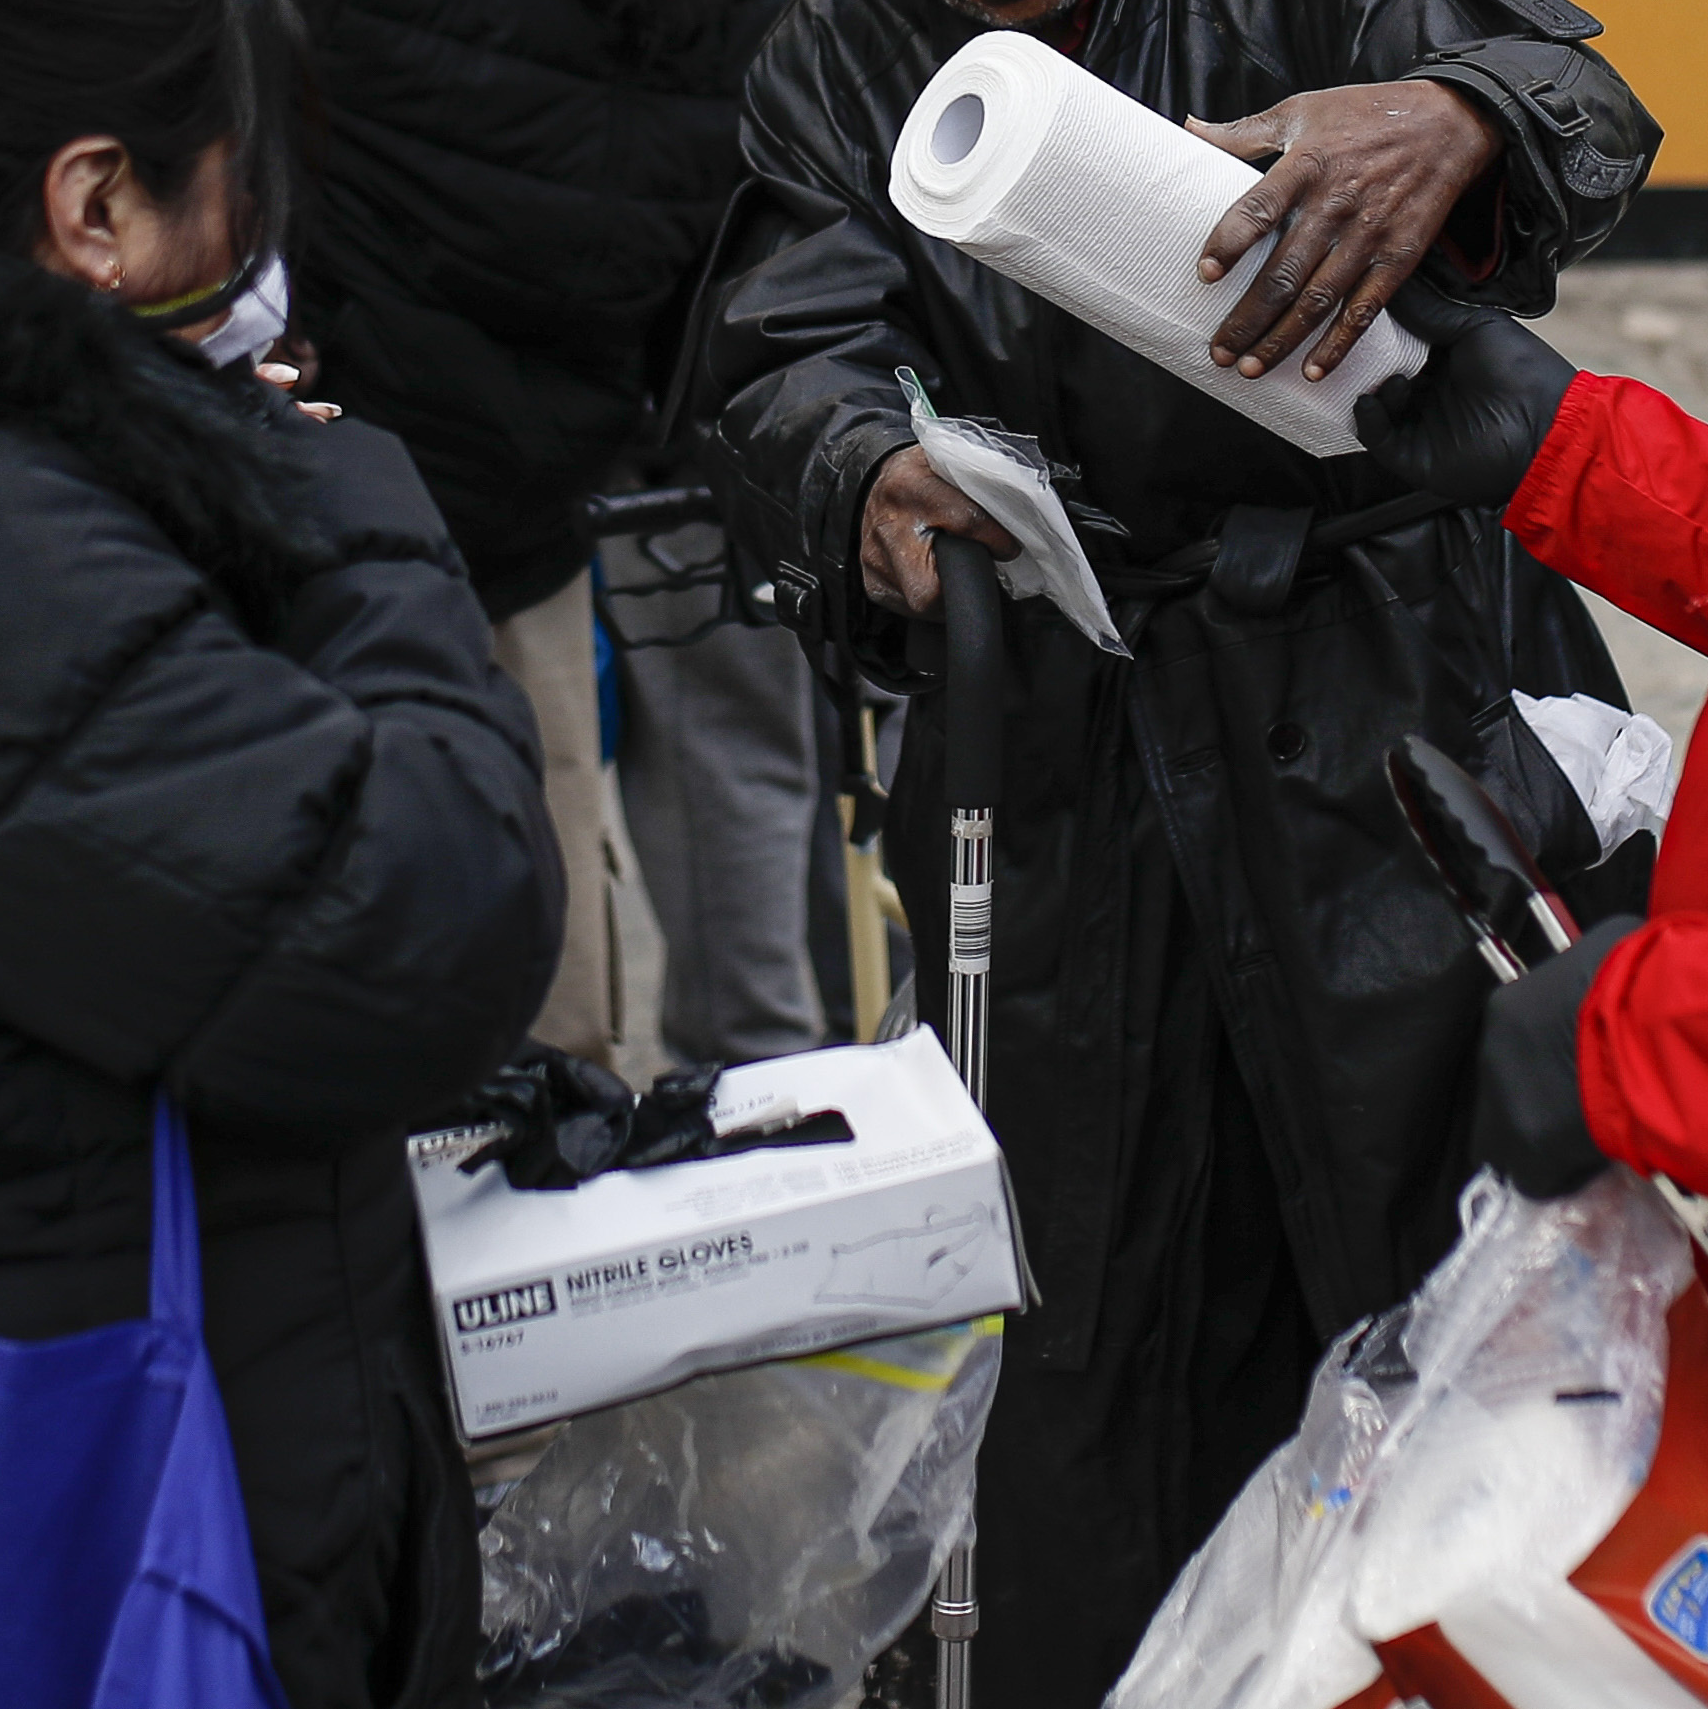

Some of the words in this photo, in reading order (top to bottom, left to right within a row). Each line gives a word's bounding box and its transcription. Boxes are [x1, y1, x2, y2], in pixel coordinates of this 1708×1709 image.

[457, 1283, 554, 1331] ULINE
[566, 1255, 649, 1292] NITRILE
[658, 1230, 754, 1275] GLOVES
